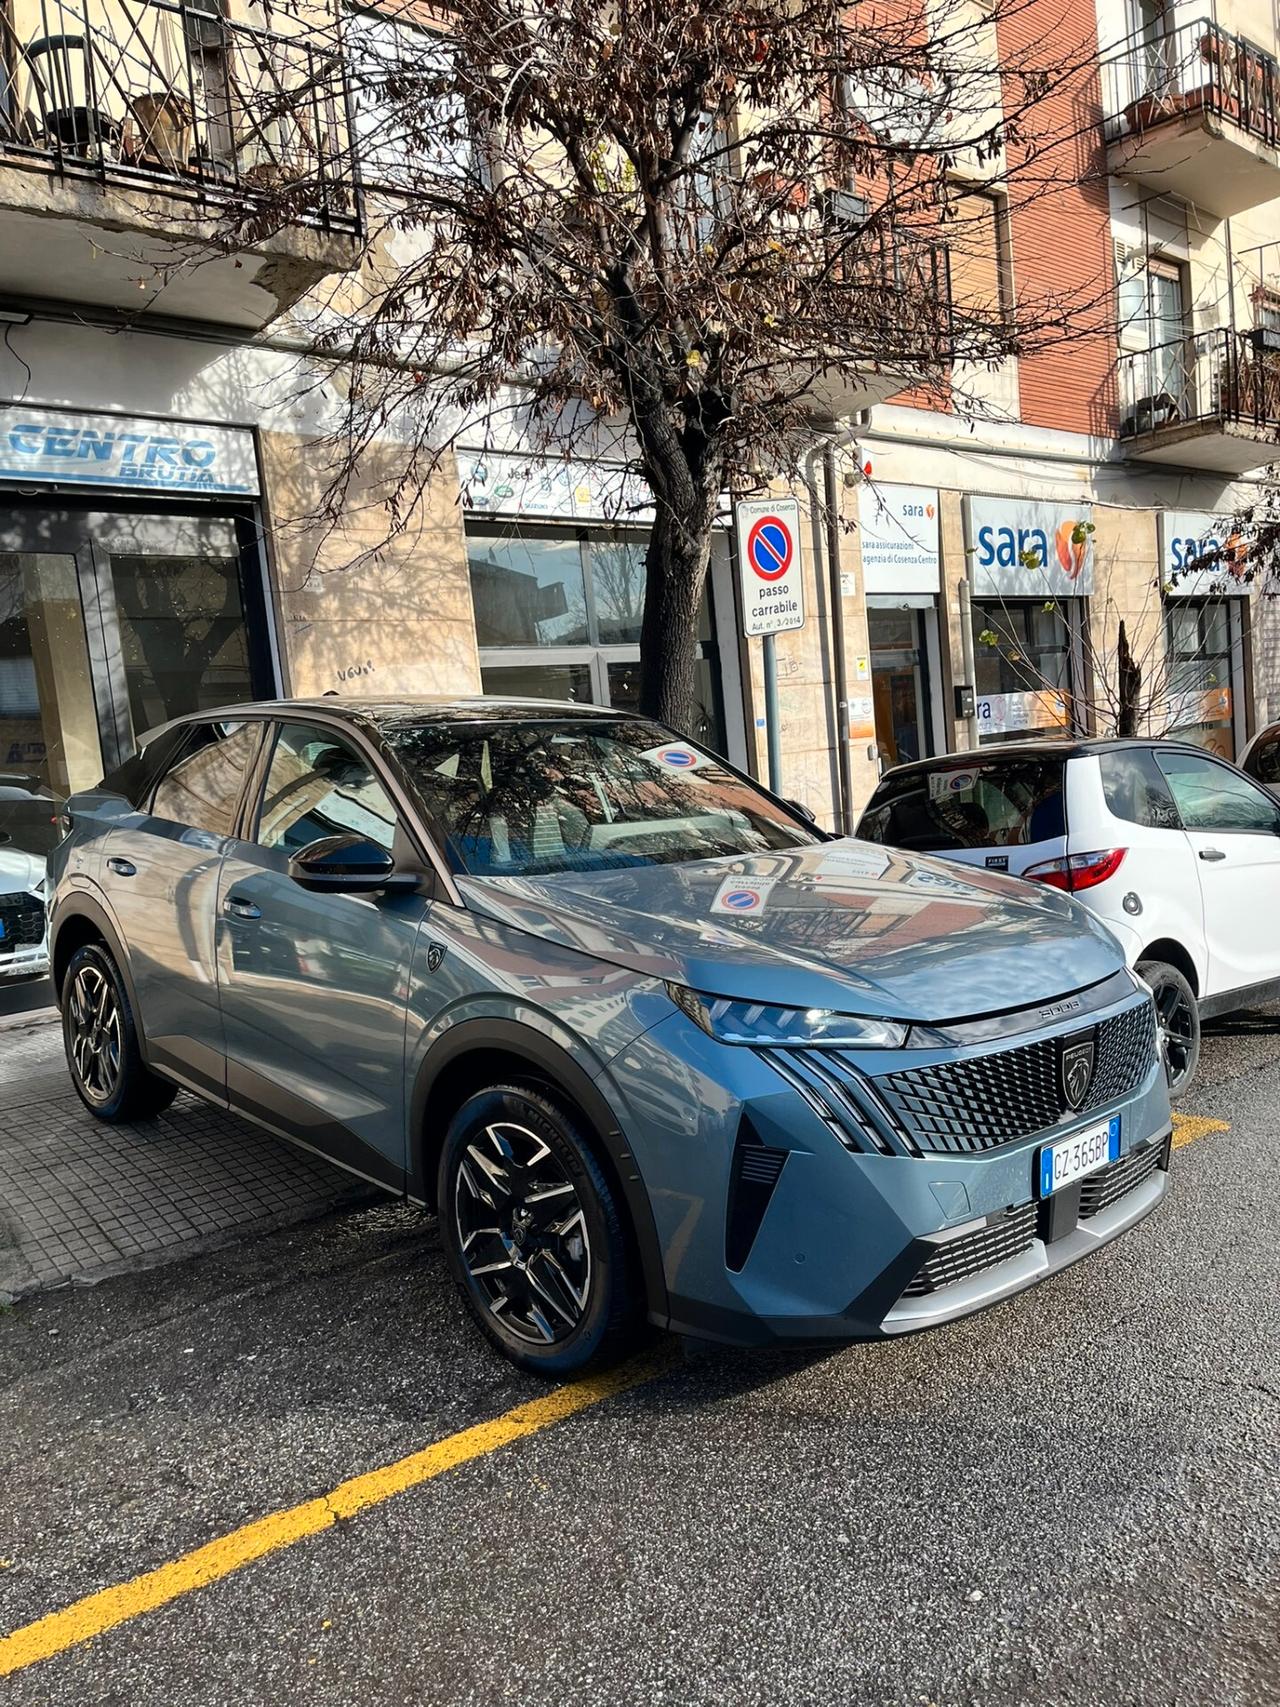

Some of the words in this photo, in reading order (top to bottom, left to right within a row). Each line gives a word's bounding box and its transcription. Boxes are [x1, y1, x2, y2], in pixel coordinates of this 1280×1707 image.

[8, 424, 217, 468] CENTRO
[119, 462, 215, 483] BRUTIA
[750, 506, 770, 514] Comune
[776, 503, 796, 512] Cosenza
[903, 505, 924, 517] sara
[862, 541, 875, 549] sara
[876, 541, 915, 550] assicurazioni
[978, 525, 1049, 568] sara
[863, 555, 887, 566] agenzia
[888, 555, 894, 563] di
[894, 554, 918, 564] Cosenza
[918, 554, 937, 564] Centro
[1171, 537, 1220, 572] sara
[759, 585, 789, 600] passo
[752, 600, 798, 617] carrabile
[1054, 1149, 1070, 1180] GZ
[1073, 1131, 1109, 1171] 365BP
